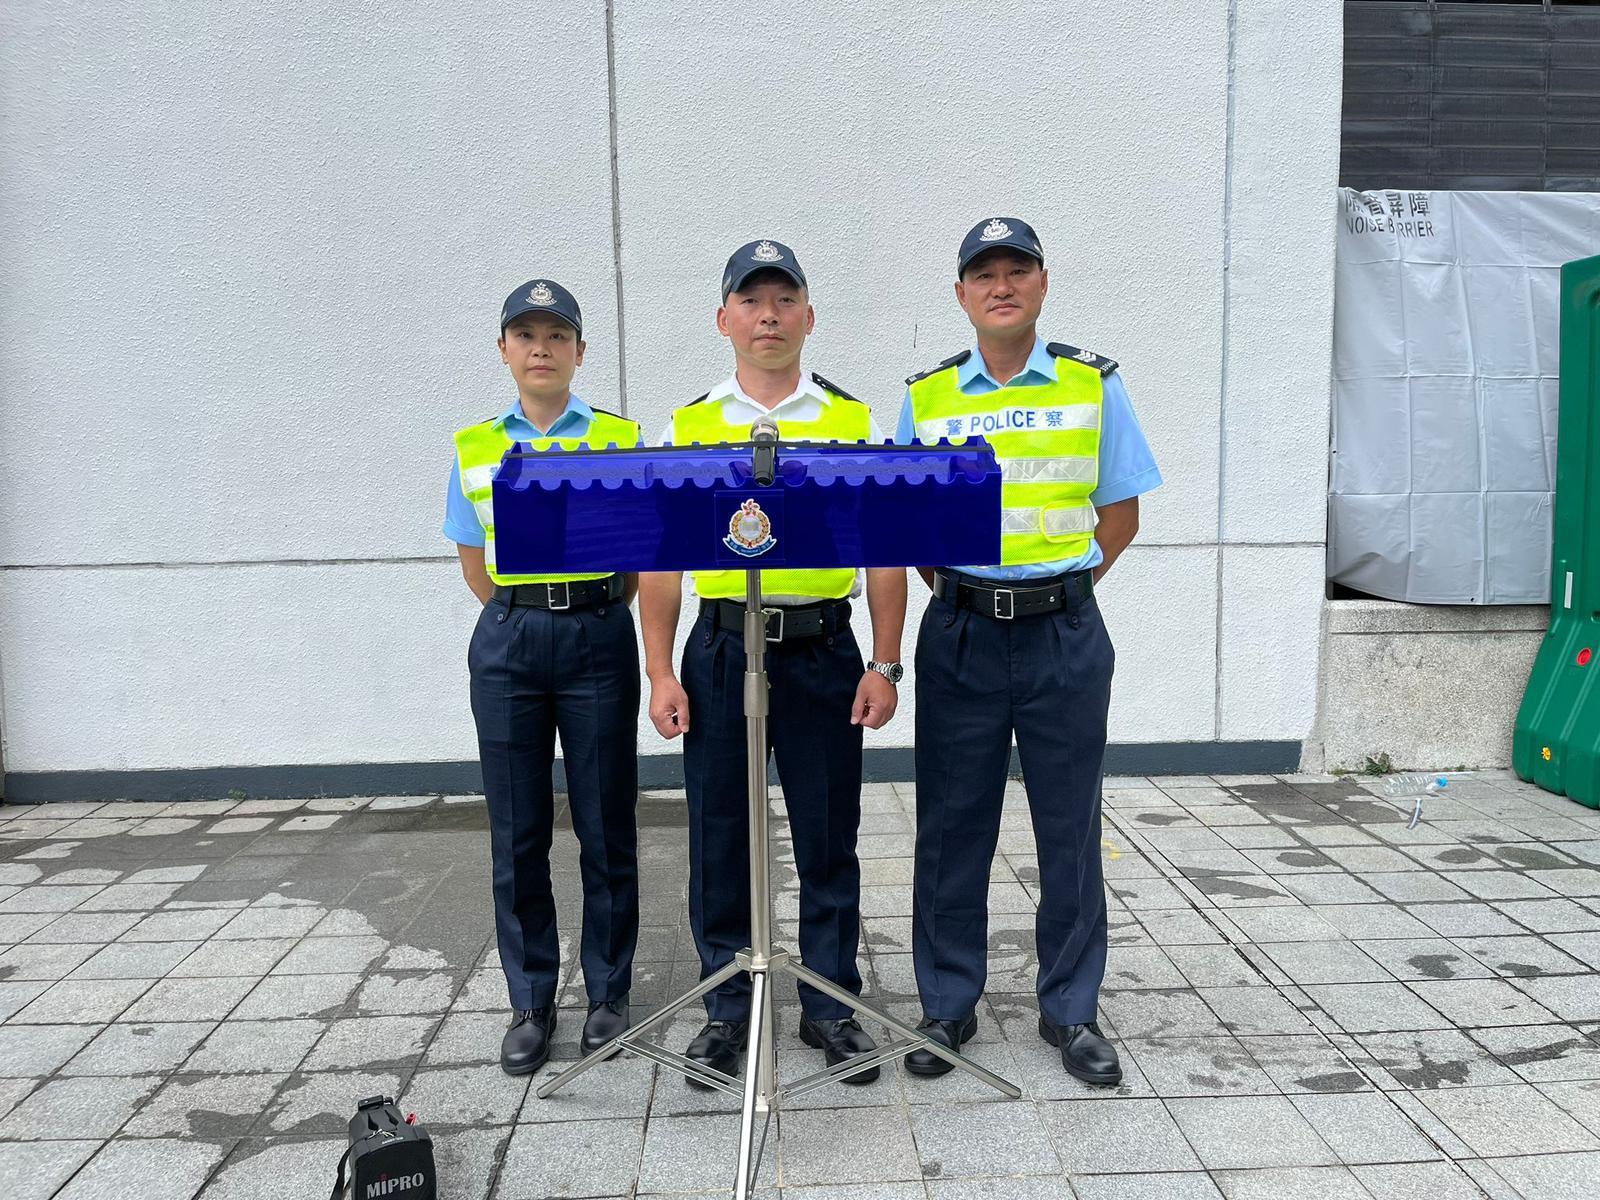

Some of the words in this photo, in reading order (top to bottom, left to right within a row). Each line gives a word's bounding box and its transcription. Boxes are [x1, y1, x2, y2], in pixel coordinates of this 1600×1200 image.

[1346, 216, 1385, 235] NOISE
[1388, 218, 1434, 237] BRRIER
[970, 410, 1035, 432] POLICE
[1045, 411, 1063, 426] 察
